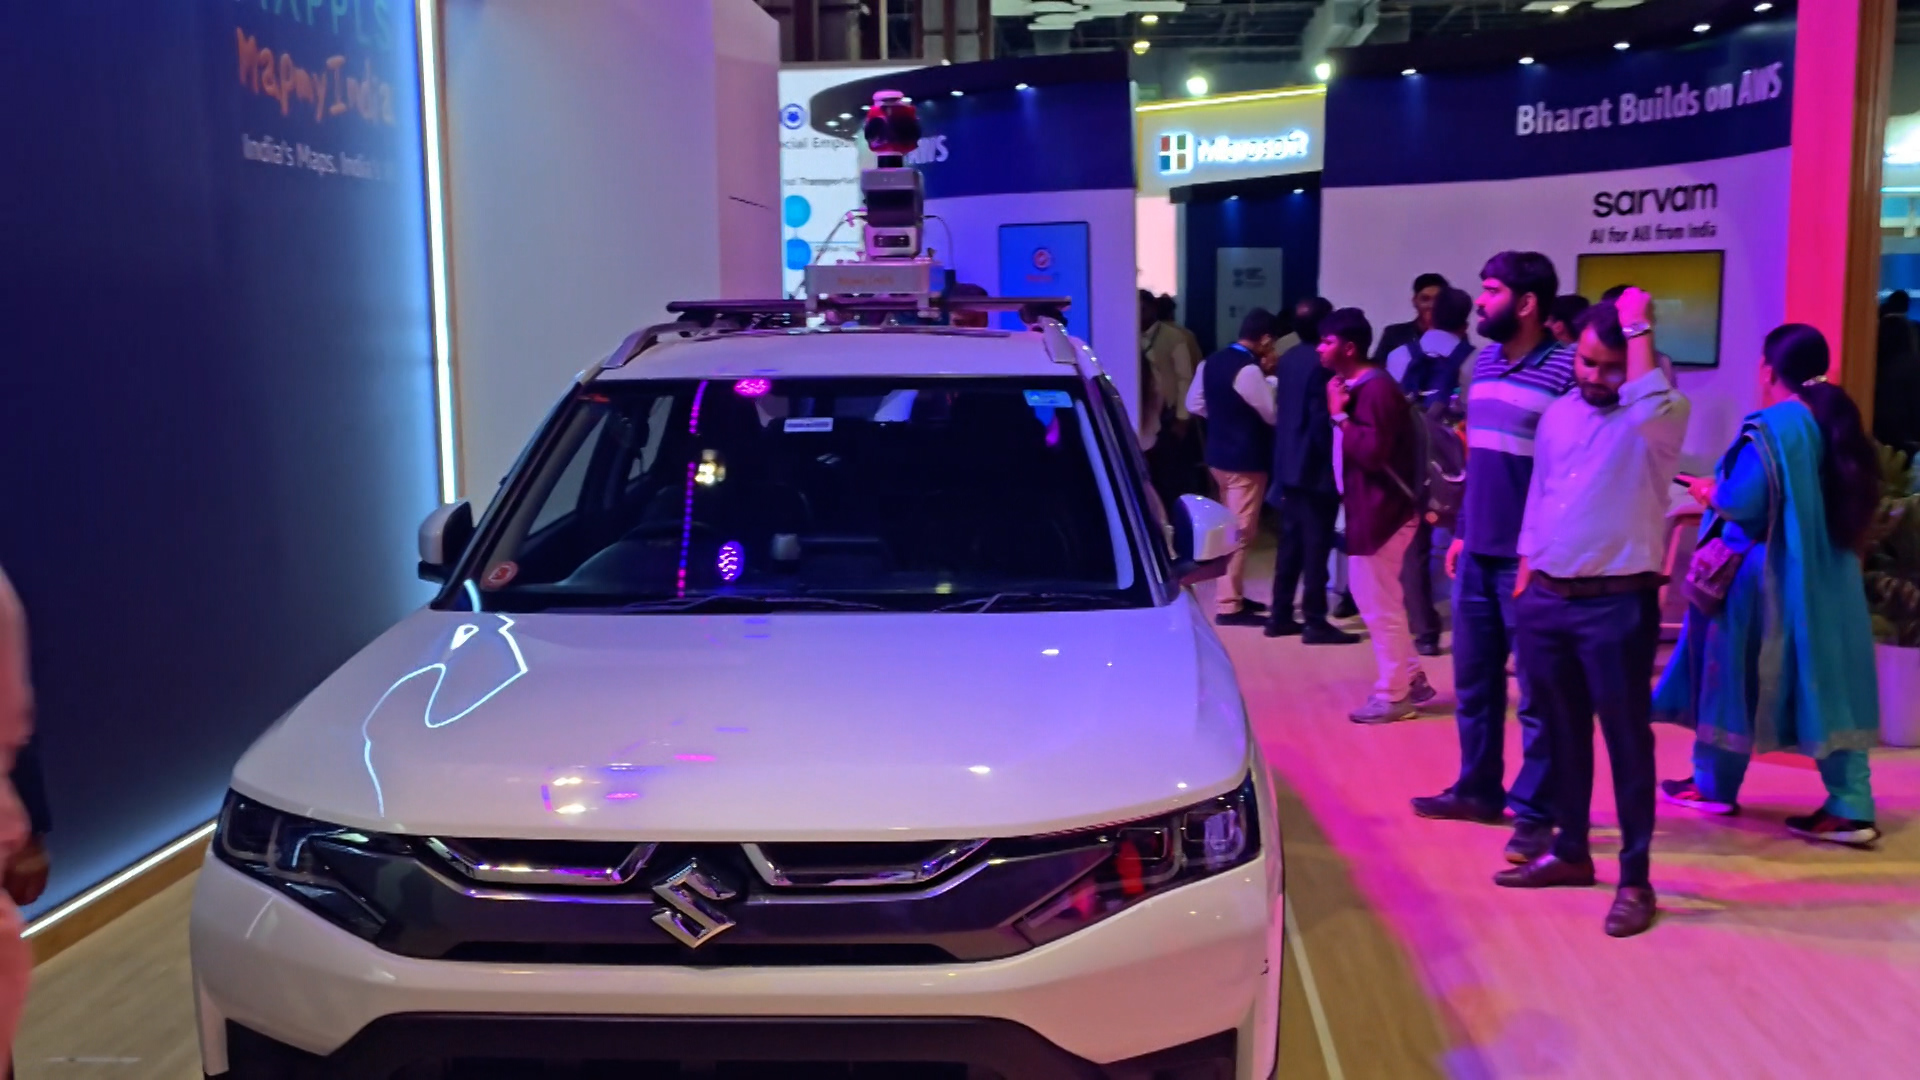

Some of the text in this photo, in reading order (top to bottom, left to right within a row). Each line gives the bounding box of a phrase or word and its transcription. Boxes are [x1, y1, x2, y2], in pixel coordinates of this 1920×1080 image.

[1515, 61, 1784, 137] Bharat Builds on AWS
[1197, 129, 1308, 164] Microsoft
[1592, 182, 1718, 218] sarvam
[1655, 223, 1685, 240] from
